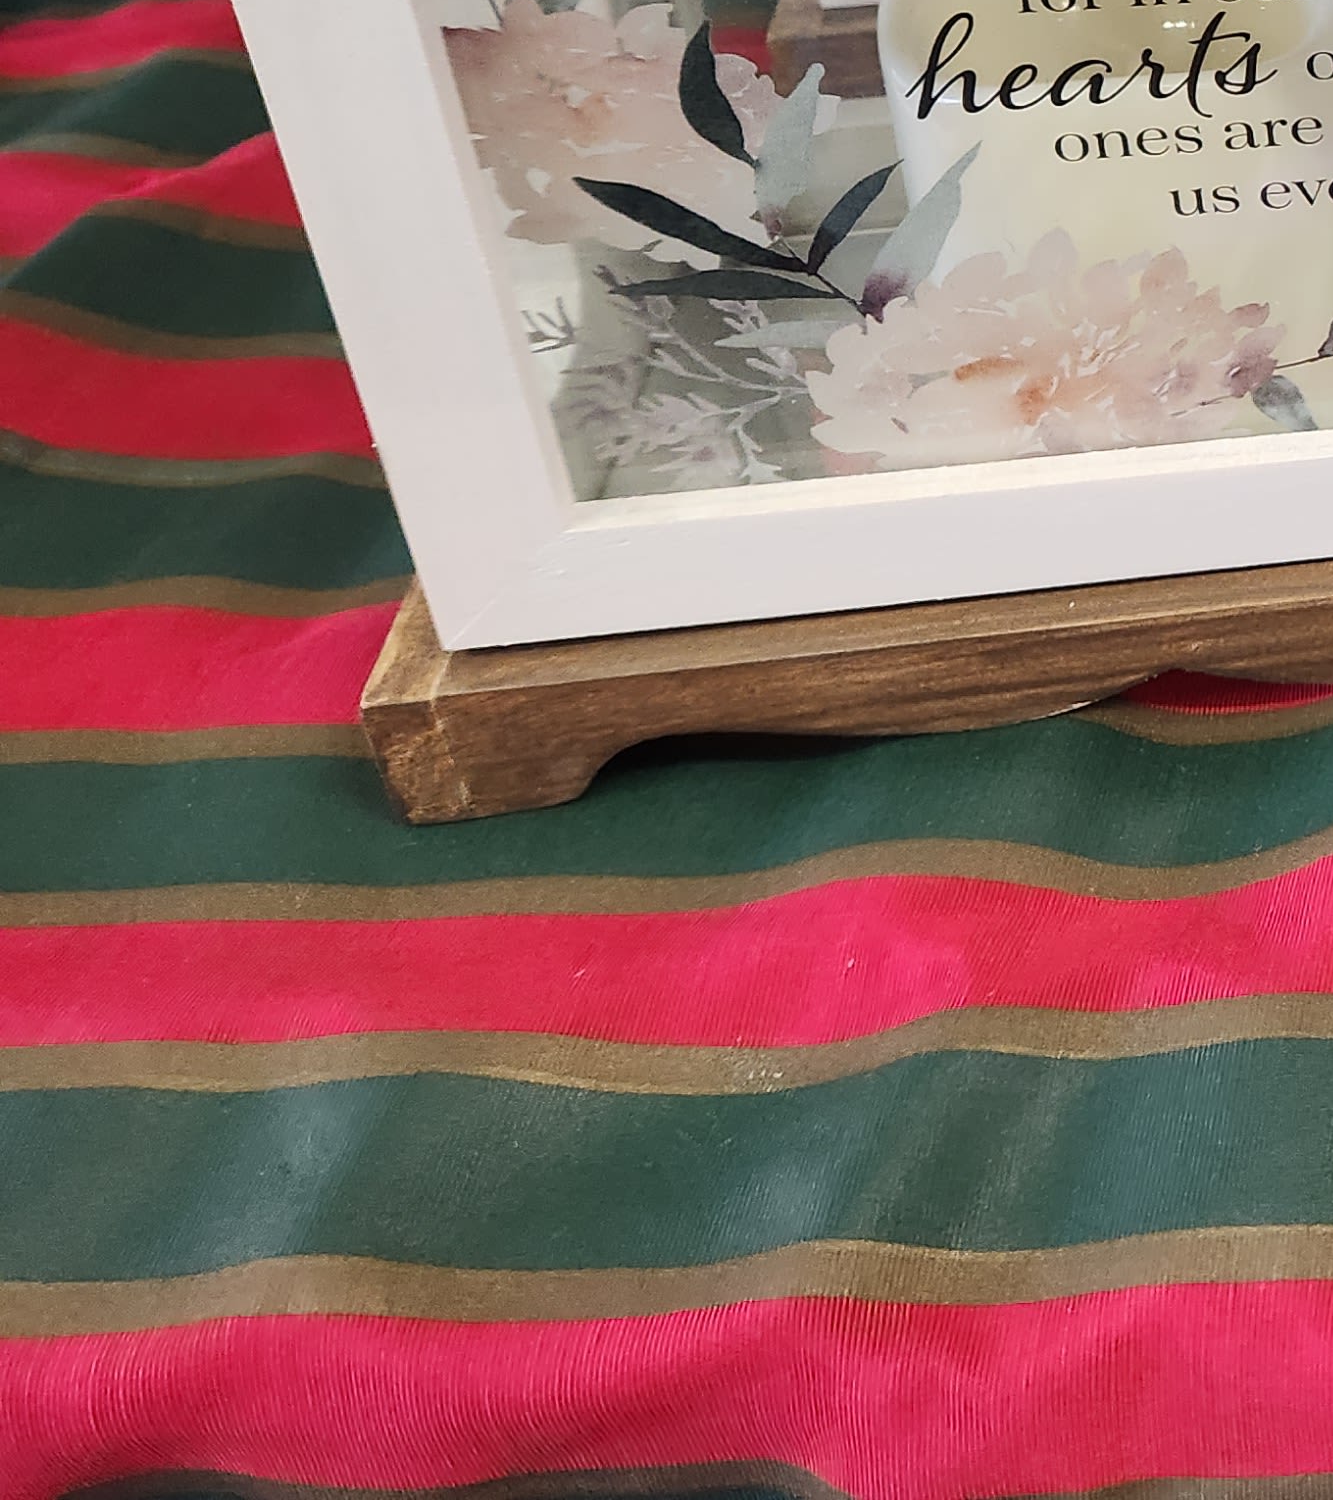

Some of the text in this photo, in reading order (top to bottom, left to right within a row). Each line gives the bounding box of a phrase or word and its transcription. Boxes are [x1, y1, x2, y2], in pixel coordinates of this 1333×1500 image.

[905, 11, 1279, 120] hearts
[1054, 123, 1204, 163] ones
[1224, 115, 1324, 150] are
[1168, 181, 1241, 217] us
